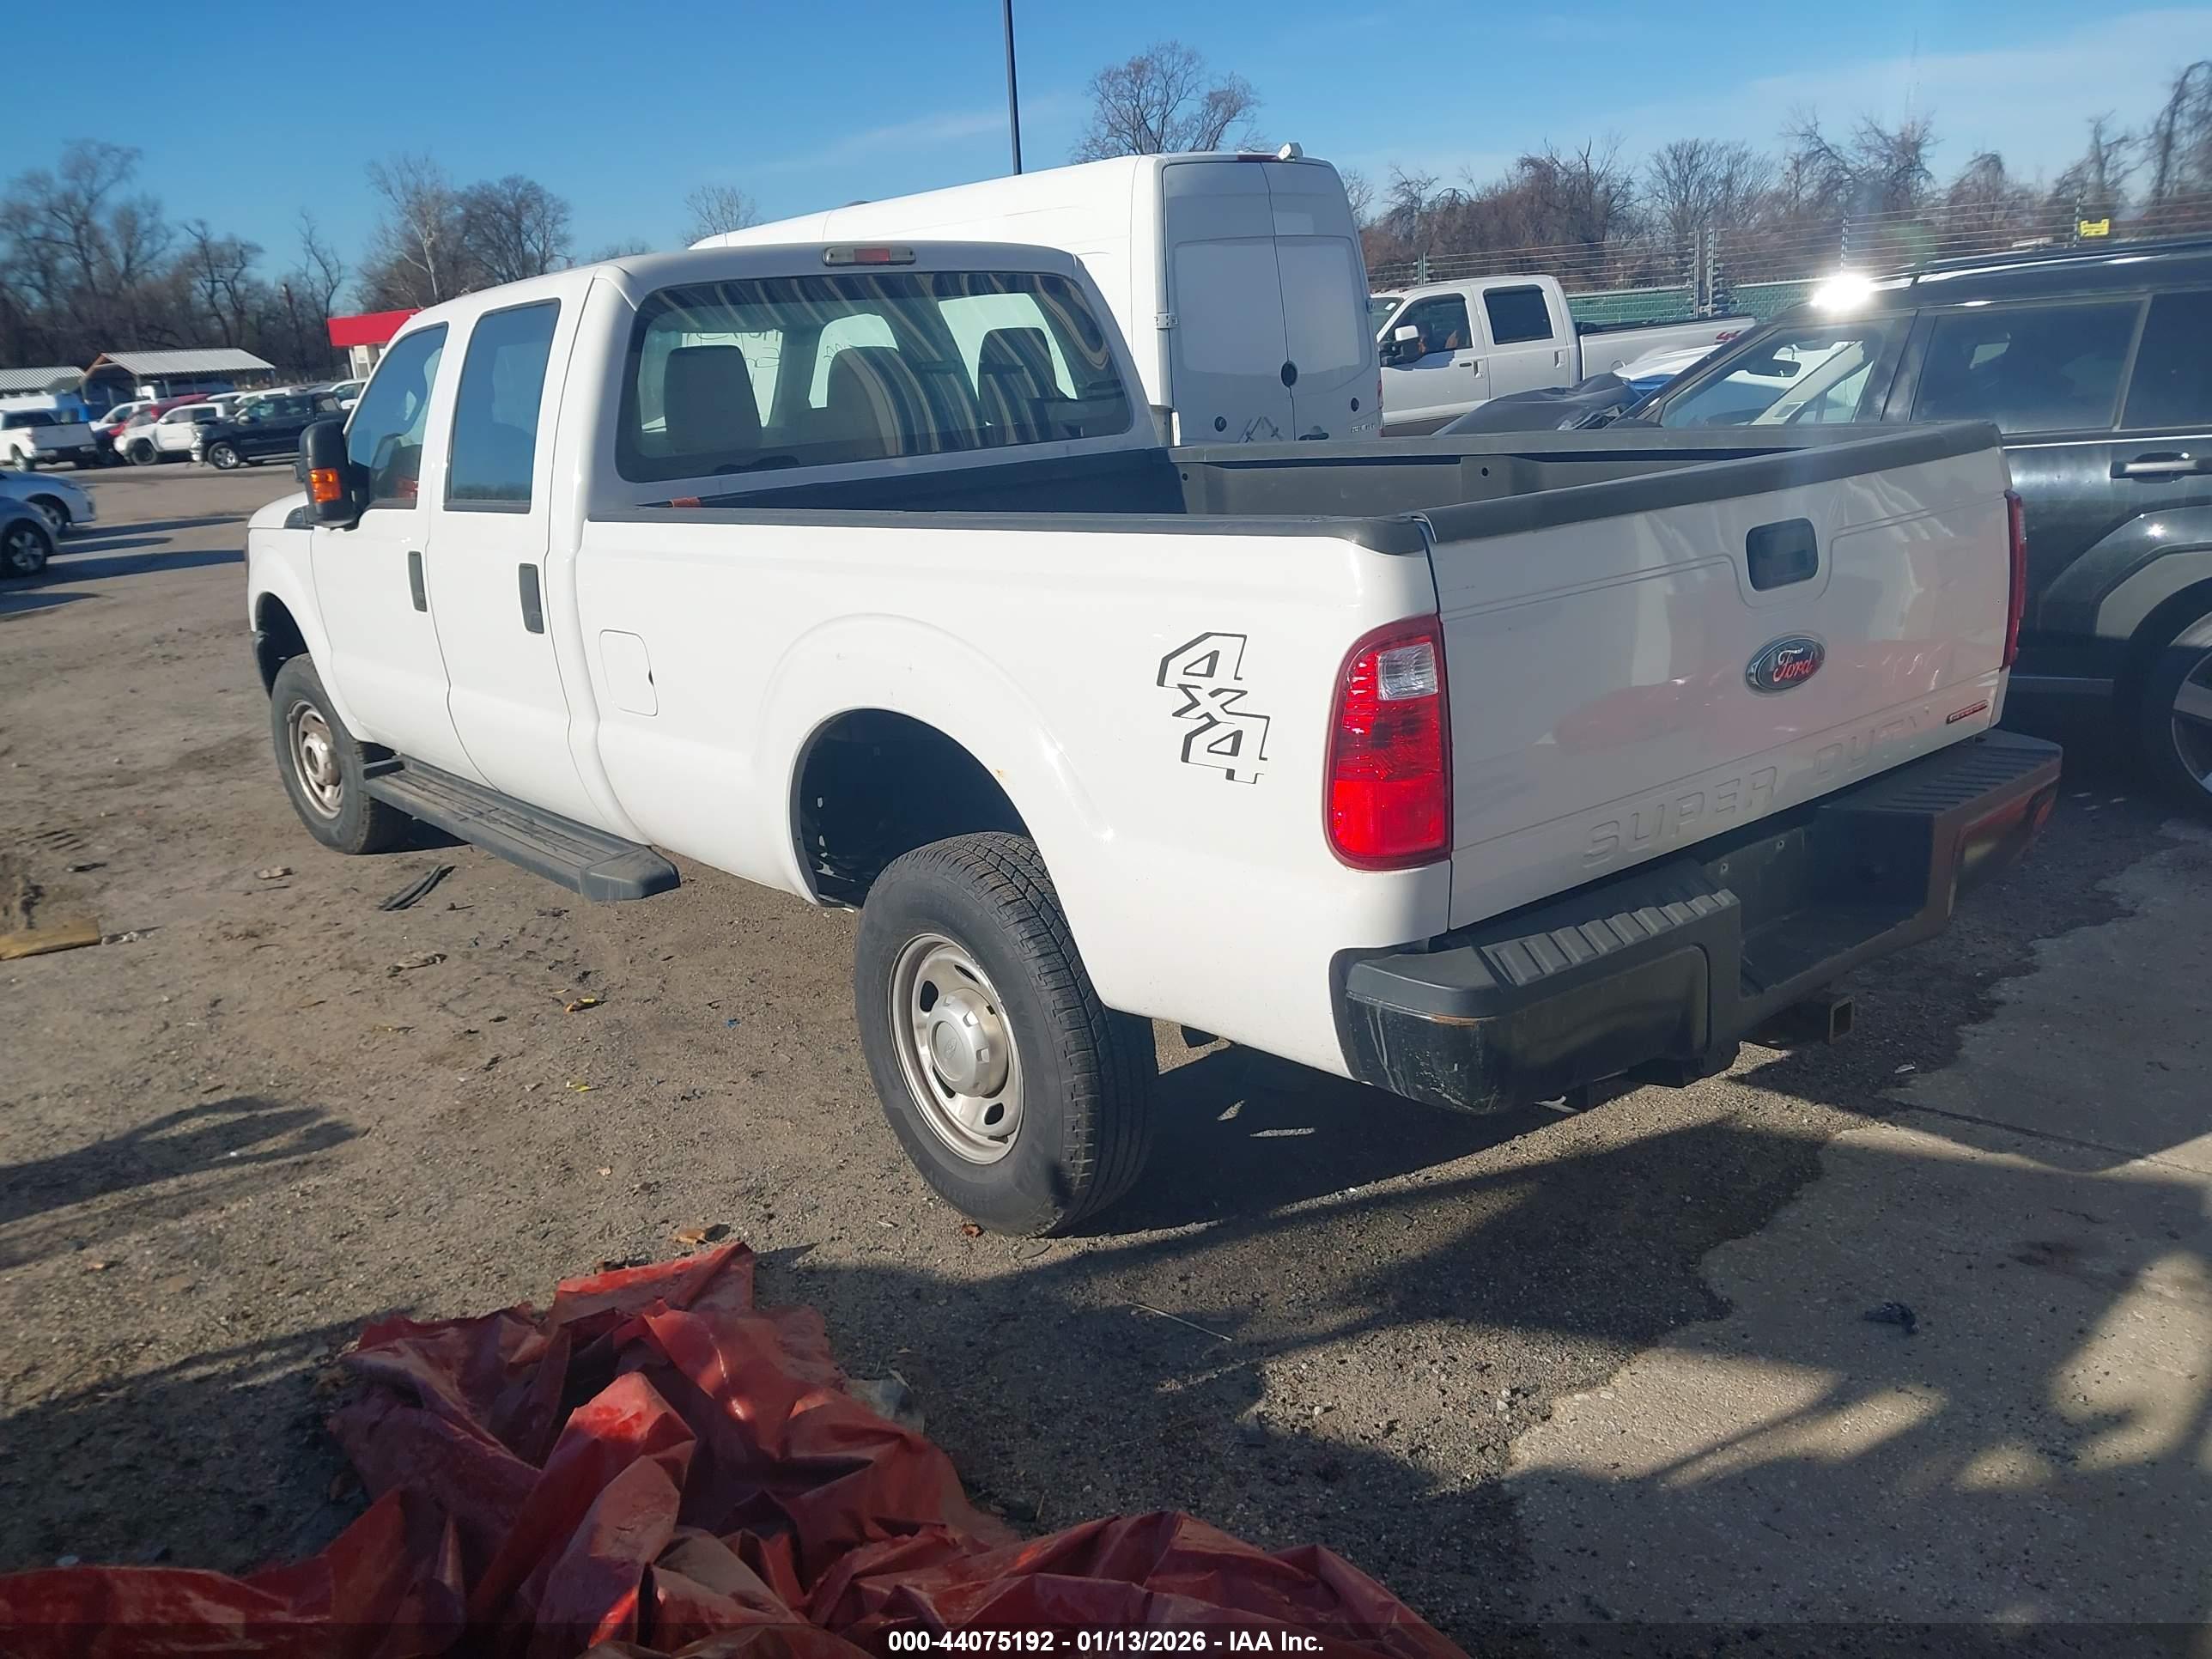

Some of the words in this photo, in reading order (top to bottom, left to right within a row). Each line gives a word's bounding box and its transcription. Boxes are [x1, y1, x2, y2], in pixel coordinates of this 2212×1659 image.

[1772, 647, 1813, 683] Ford
[1583, 765, 1778, 868] SUPER
[1813, 706, 1931, 787] DUTY
